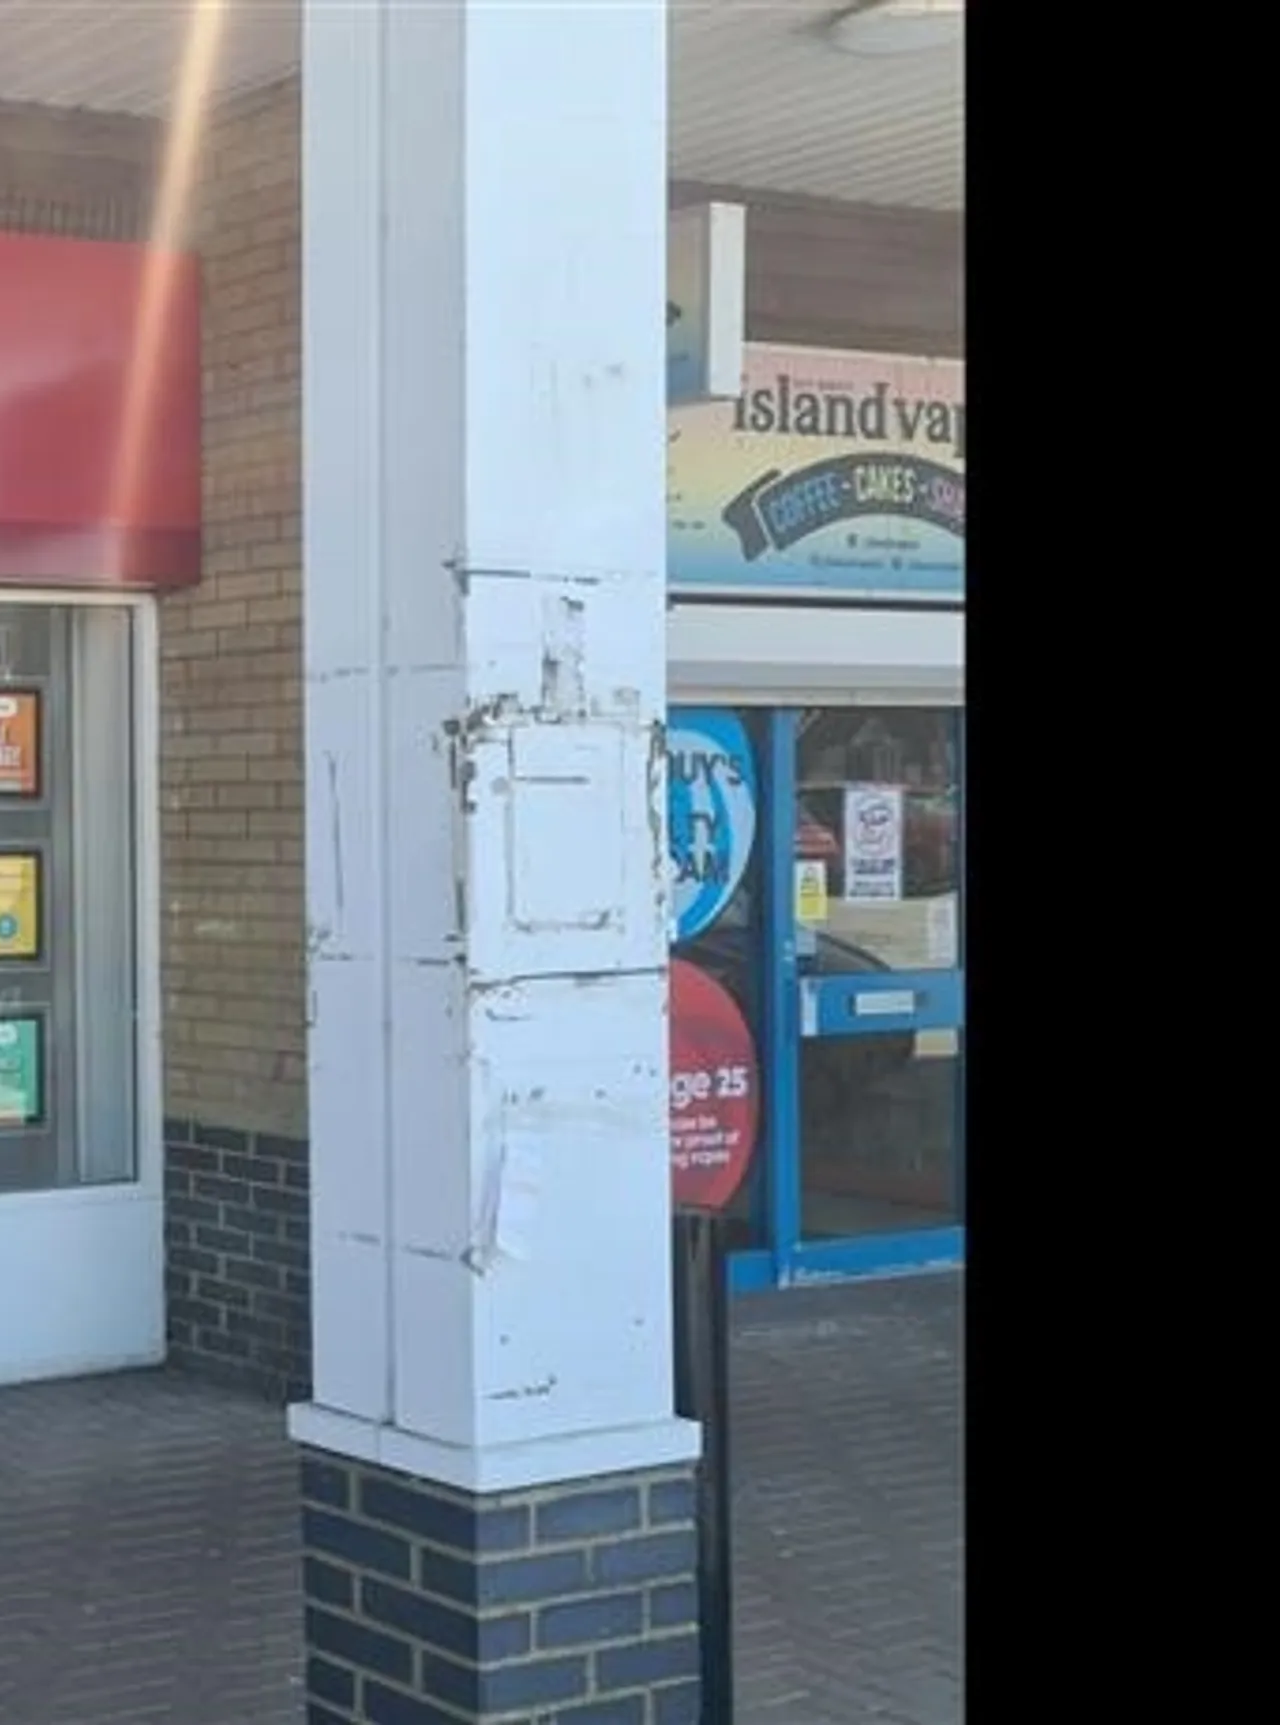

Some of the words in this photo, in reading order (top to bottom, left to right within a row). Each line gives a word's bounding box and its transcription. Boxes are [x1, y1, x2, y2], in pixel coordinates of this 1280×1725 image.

[854, 464, 916, 503] CAKES
[670, 1070, 712, 1110] ge
[716, 1066, 749, 1098] 25
